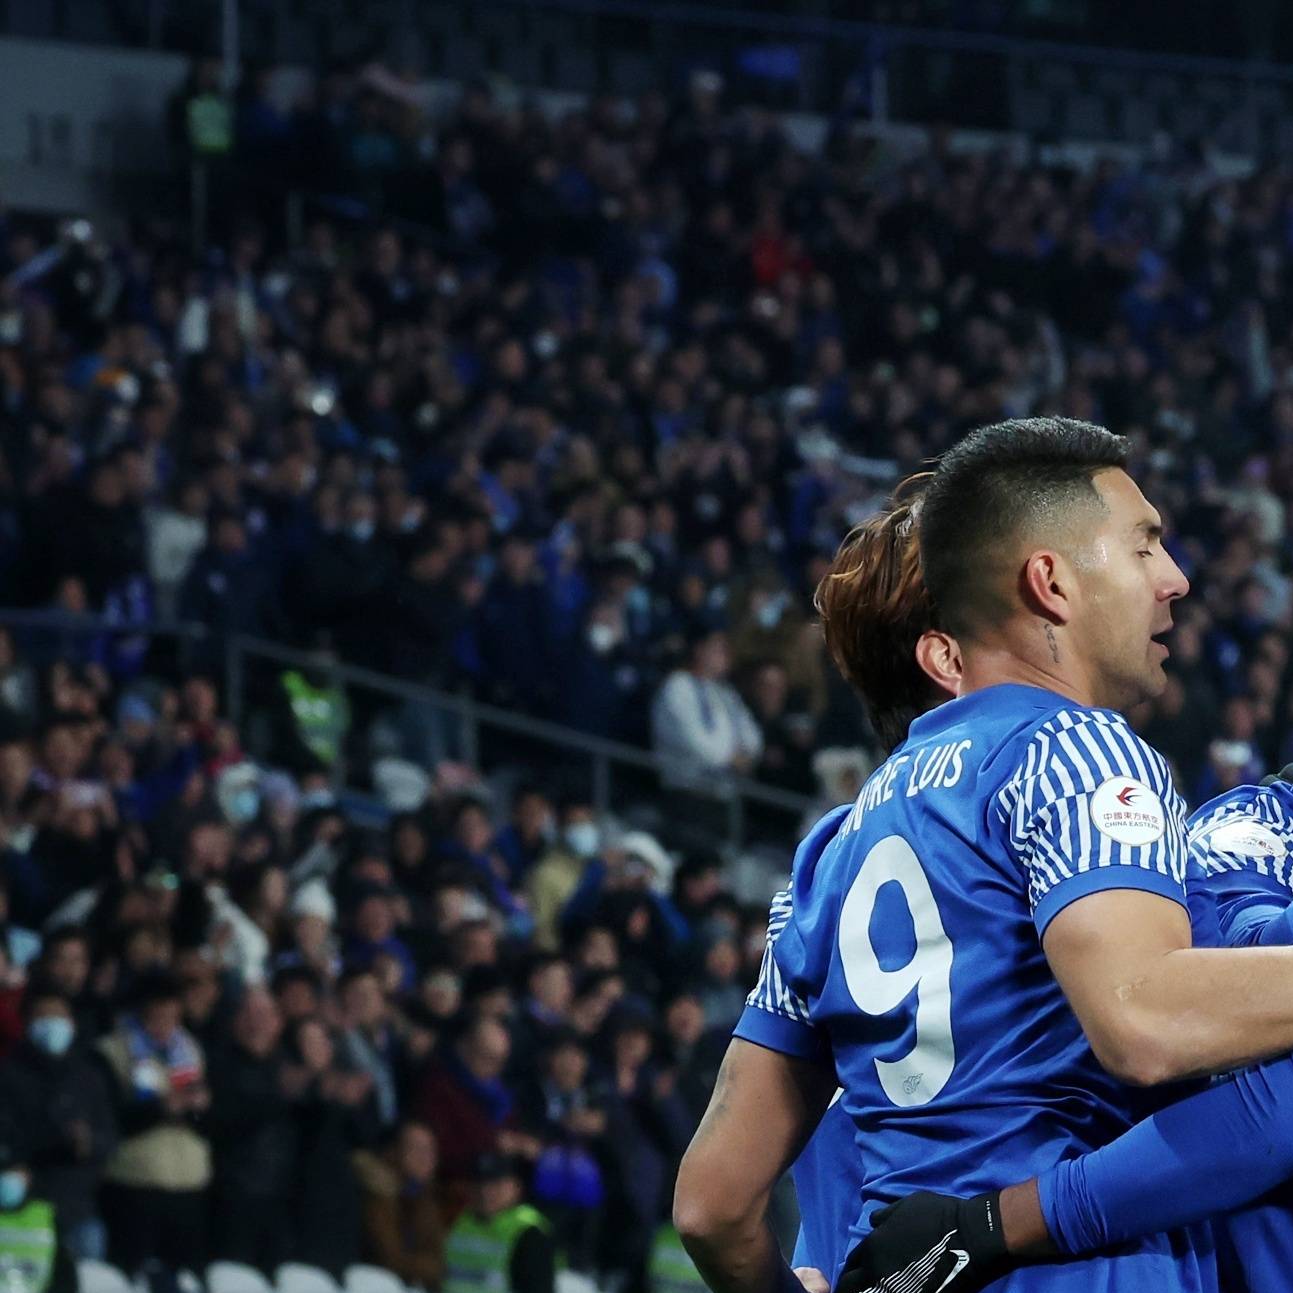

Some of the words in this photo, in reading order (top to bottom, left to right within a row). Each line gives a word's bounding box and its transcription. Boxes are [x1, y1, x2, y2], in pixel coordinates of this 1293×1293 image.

[906, 739, 972, 797] LUIS
[1129, 821, 1160, 831] EASTERN
[839, 835, 954, 1107] 9
